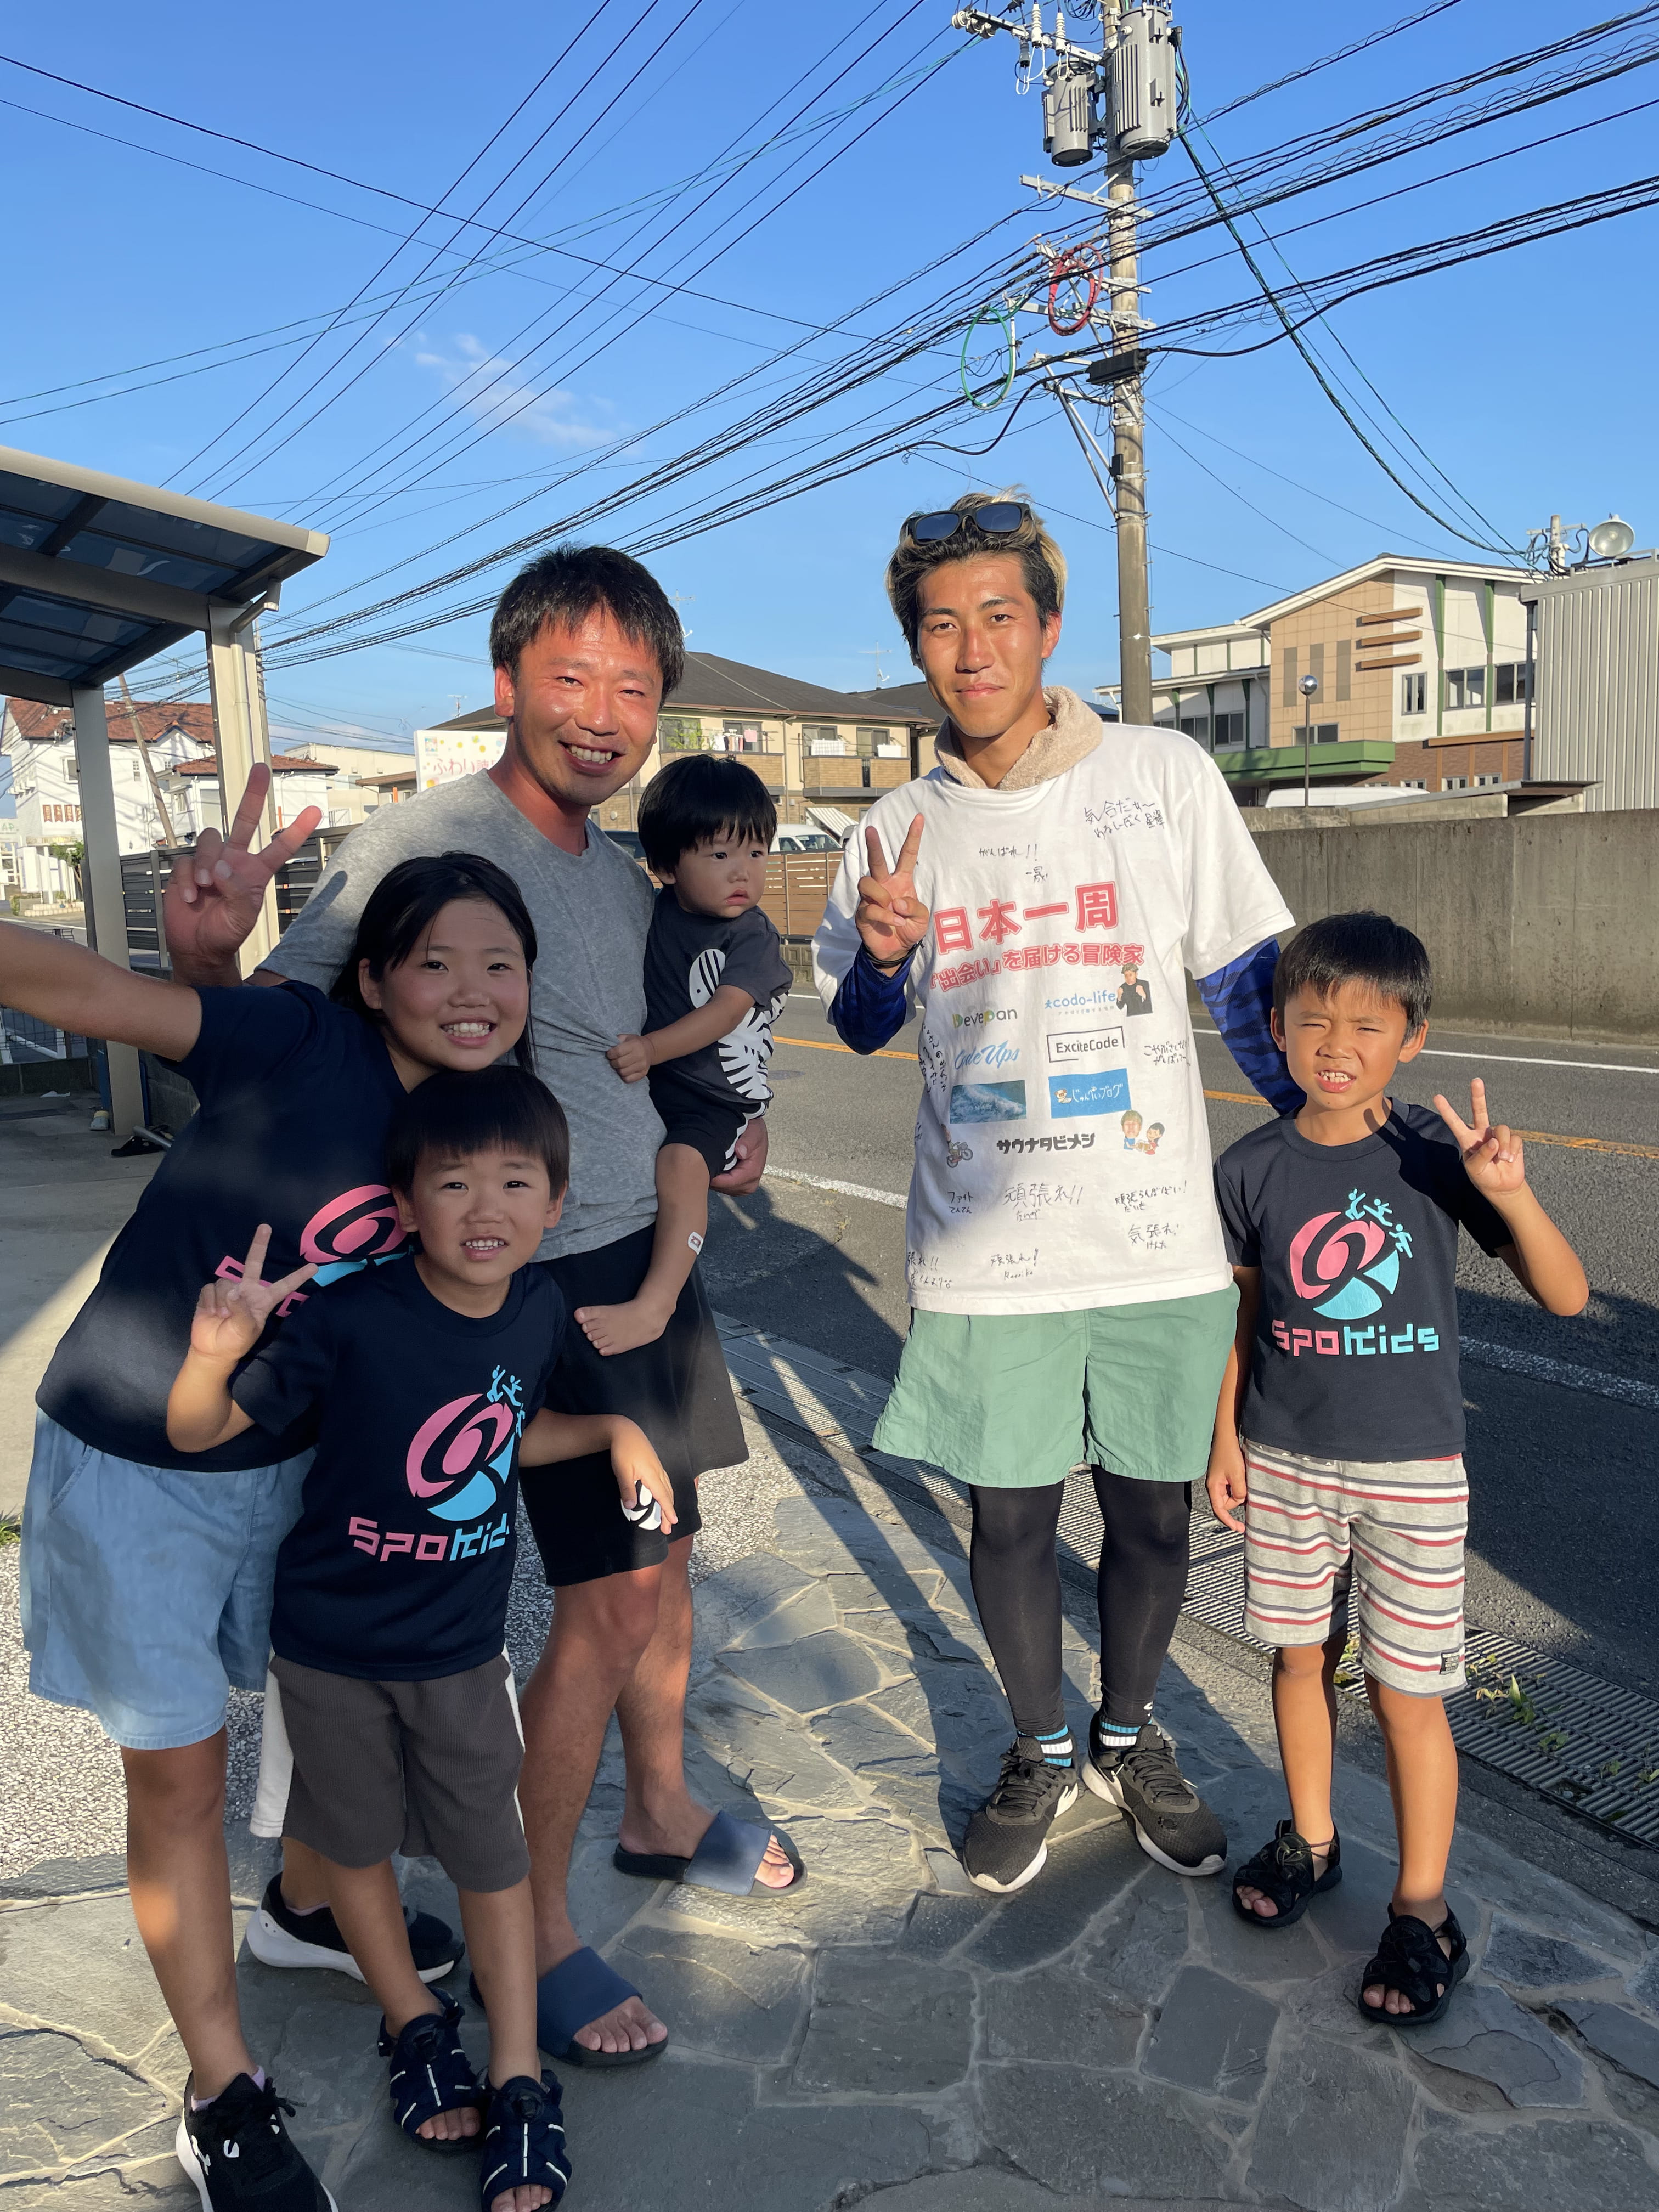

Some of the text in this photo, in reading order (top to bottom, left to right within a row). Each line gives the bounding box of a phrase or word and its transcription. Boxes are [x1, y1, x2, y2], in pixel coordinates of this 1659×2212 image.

[934, 881, 1119, 955] 日本一周
[930, 943, 1145, 992] 「出会い」を届ける冒険家
[1056, 1036, 1119, 1054] ExciteCode
[1072, 1082, 1124, 1102] じゅんぺいブログ
[996, 1132, 1096, 1154] サウナタビメシ
[947, 1191, 974, 1204] ファイト
[1003, 1182, 1084, 1208] 頑張れ!!
